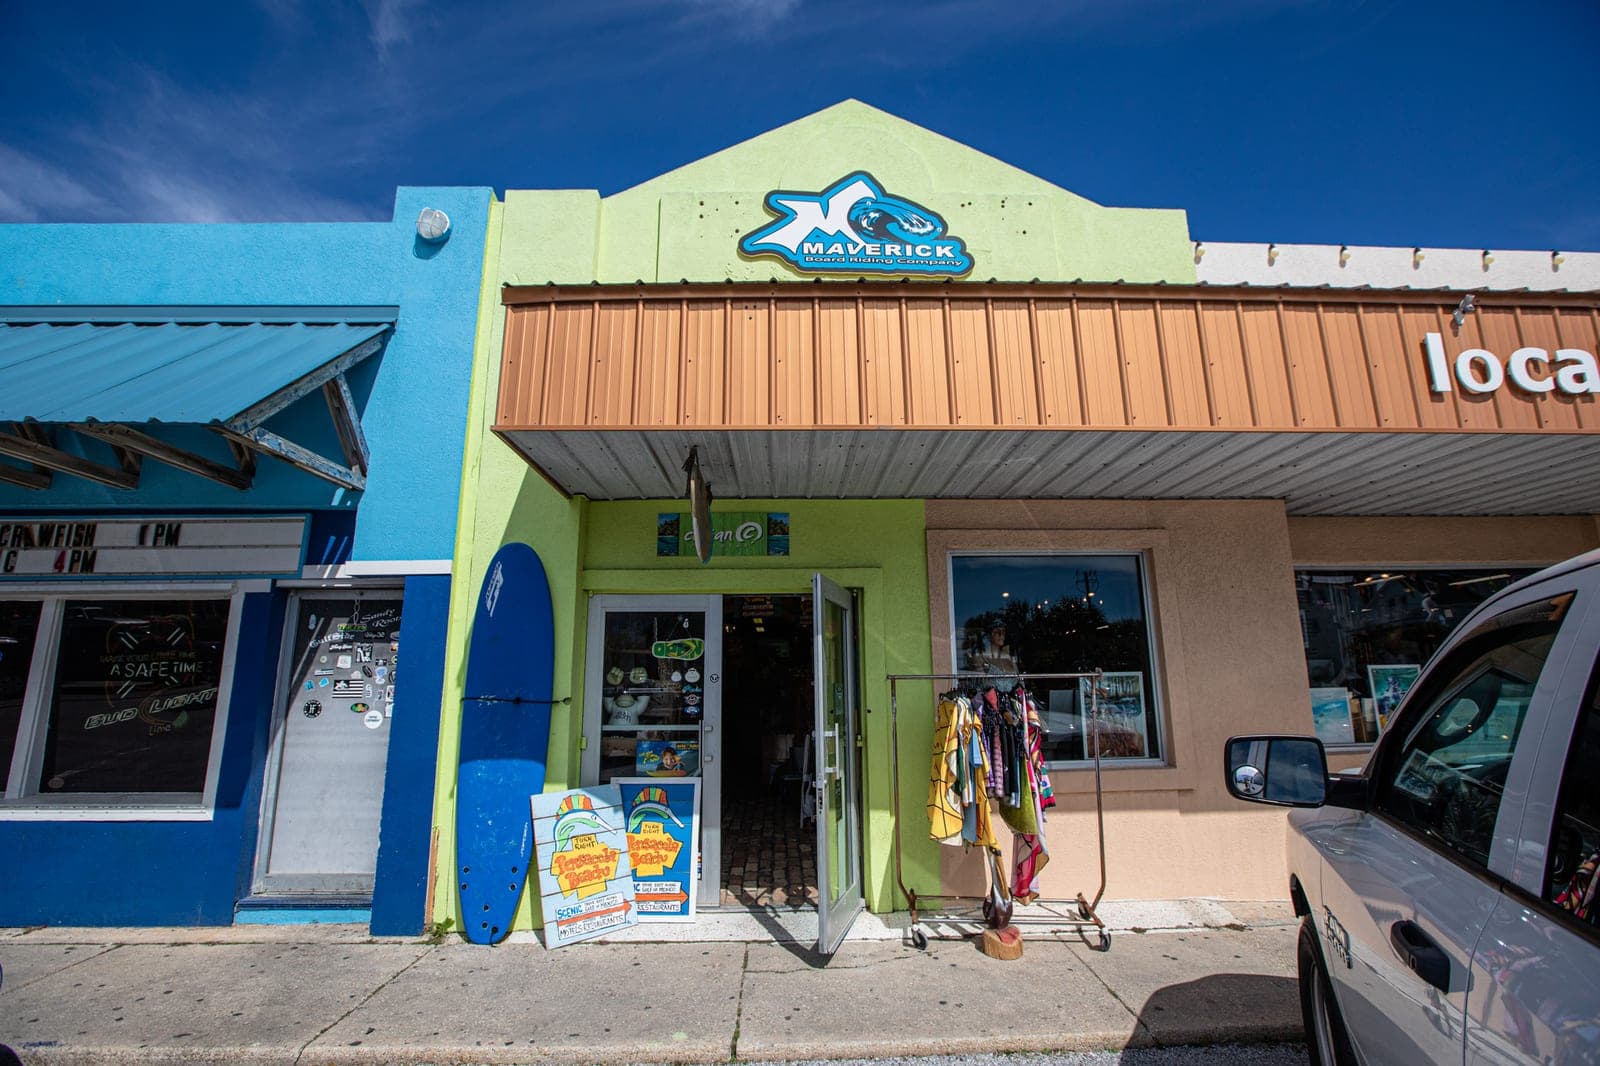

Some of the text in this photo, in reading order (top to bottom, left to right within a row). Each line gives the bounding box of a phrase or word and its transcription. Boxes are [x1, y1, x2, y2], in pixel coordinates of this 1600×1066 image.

[802, 241, 956, 258] MAVERICK
[850, 257, 893, 265] Riding
[897, 258, 963, 267] Company
[152, 524, 182, 547] PM
[53, 551, 67, 573] 4
[68, 550, 97, 574] PM
[124, 661, 170, 679] SAFE
[172, 661, 204, 674] TIME
[84, 687, 218, 730] BUD LIGHT
[557, 905, 583, 919] SCENIC
